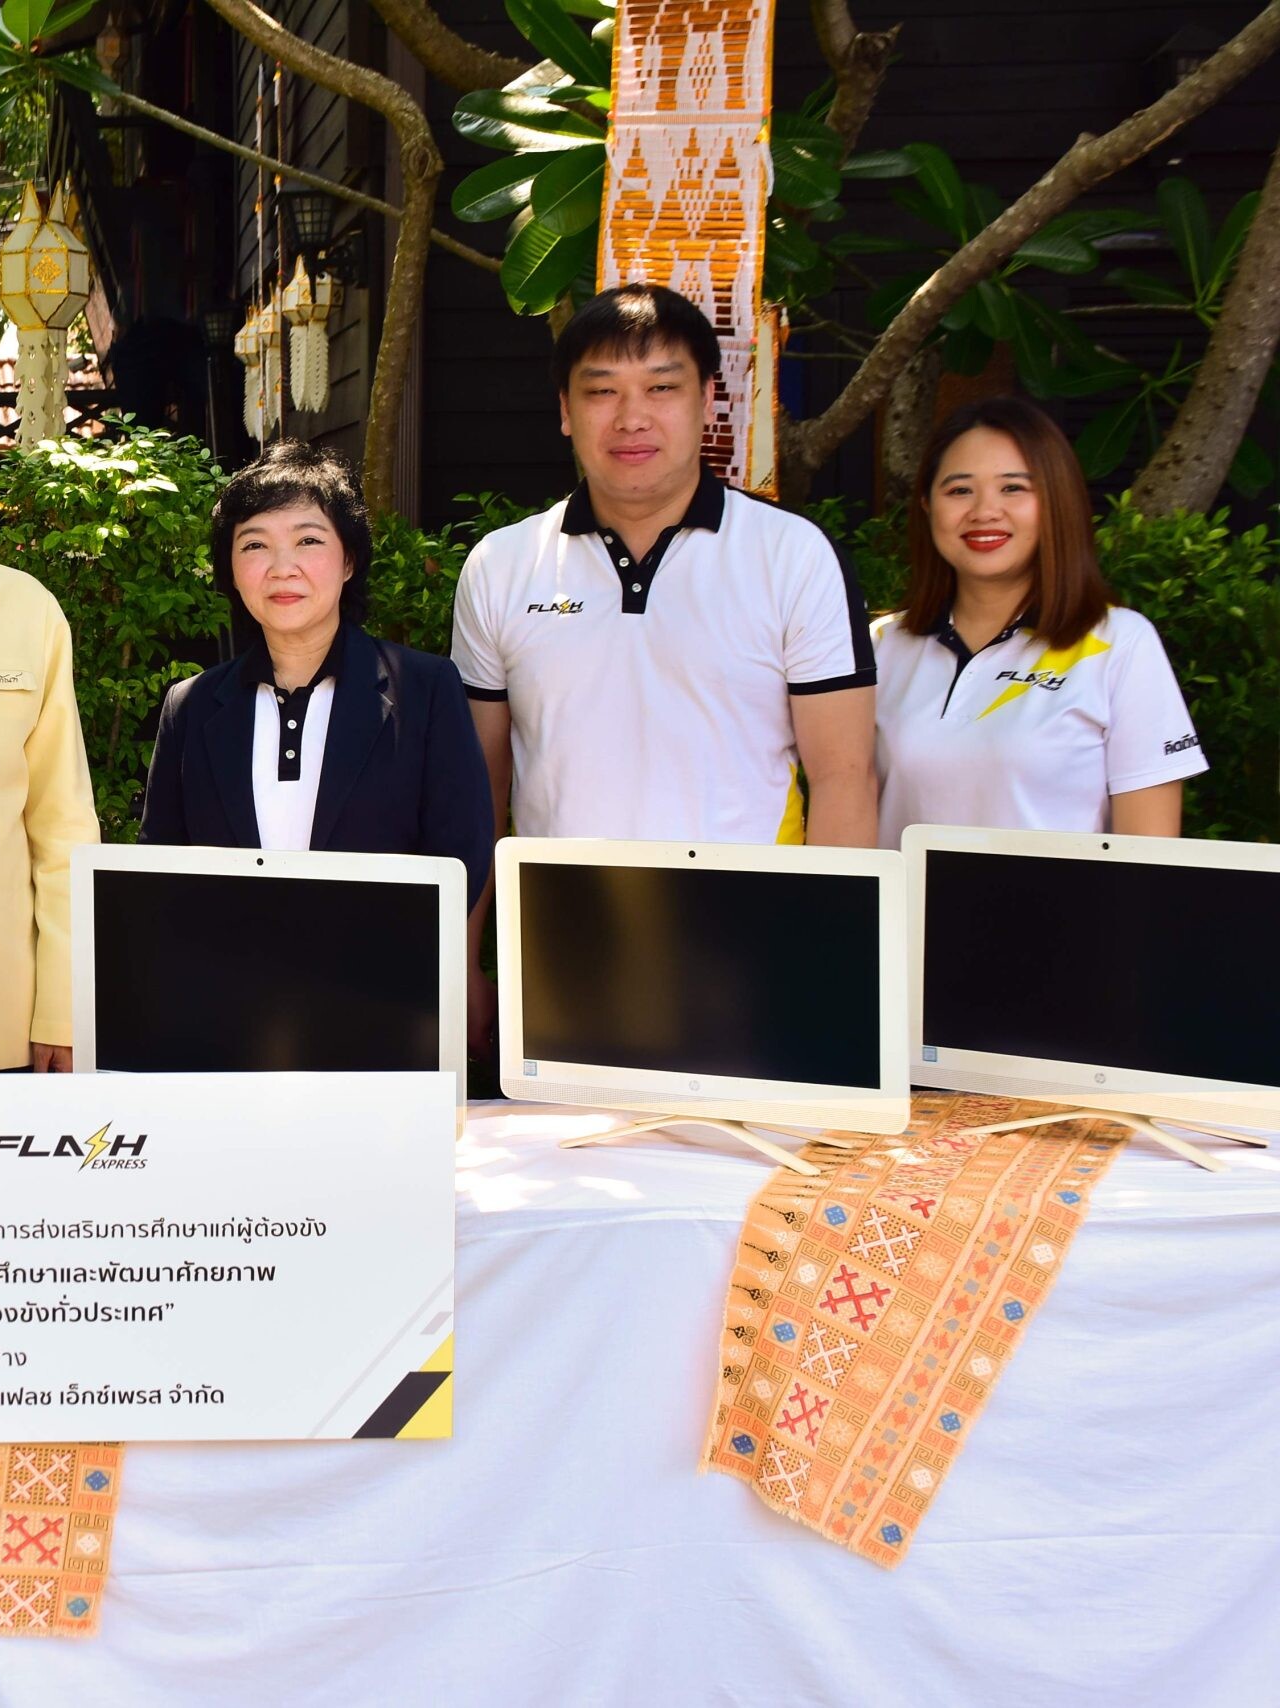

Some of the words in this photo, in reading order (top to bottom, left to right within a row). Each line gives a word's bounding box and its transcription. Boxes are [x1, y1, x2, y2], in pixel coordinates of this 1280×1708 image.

[91, 1159, 148, 1170] EXPRESS
[60, 1383, 162, 1405] เอ็กซ์เพรส
[169, 1383, 225, 1405] จำกัด
